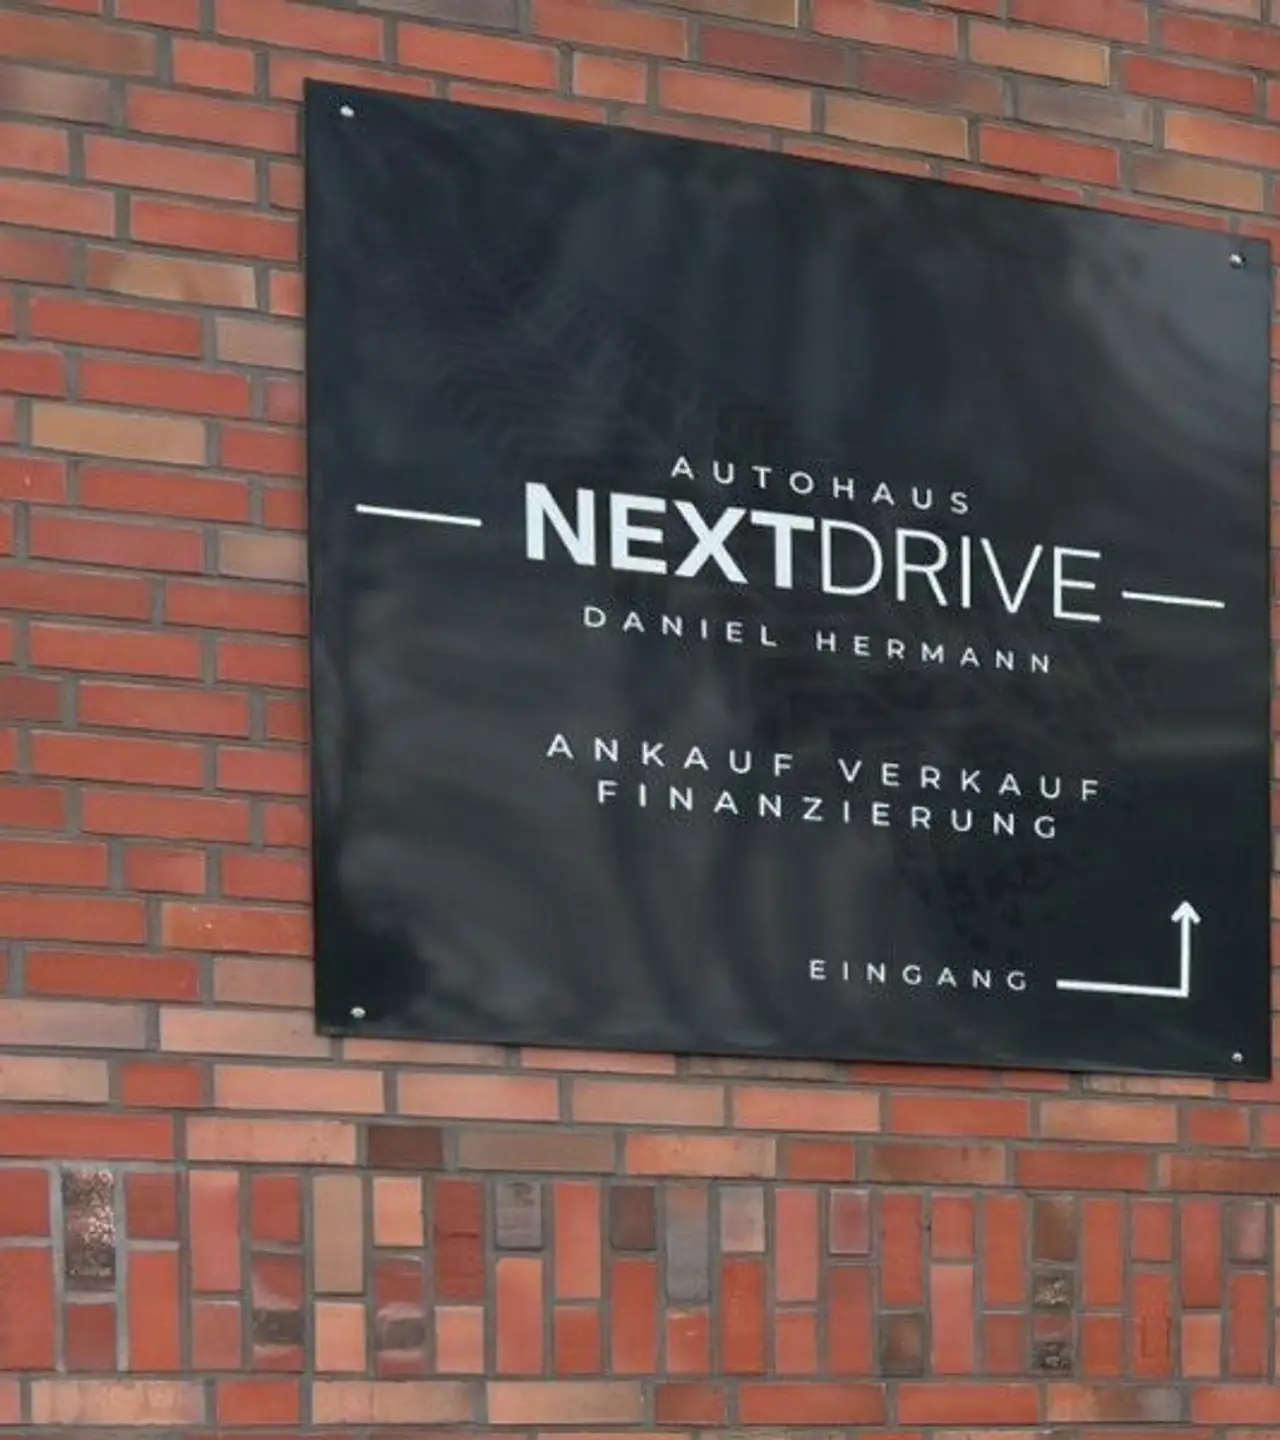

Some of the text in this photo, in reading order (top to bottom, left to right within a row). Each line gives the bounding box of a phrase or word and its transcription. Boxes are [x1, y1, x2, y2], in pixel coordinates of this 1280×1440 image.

[670, 455, 971, 516] AUTOHAUS
[524, 480, 1103, 624] NEXTDRIVE
[582, 604, 1053, 675] DANIEL HERMANN
[545, 732, 1099, 802] ANKAUF VERKAUF
[596, 778, 1056, 840] FINANZIERUNG
[808, 958, 1027, 992] EINGANG
